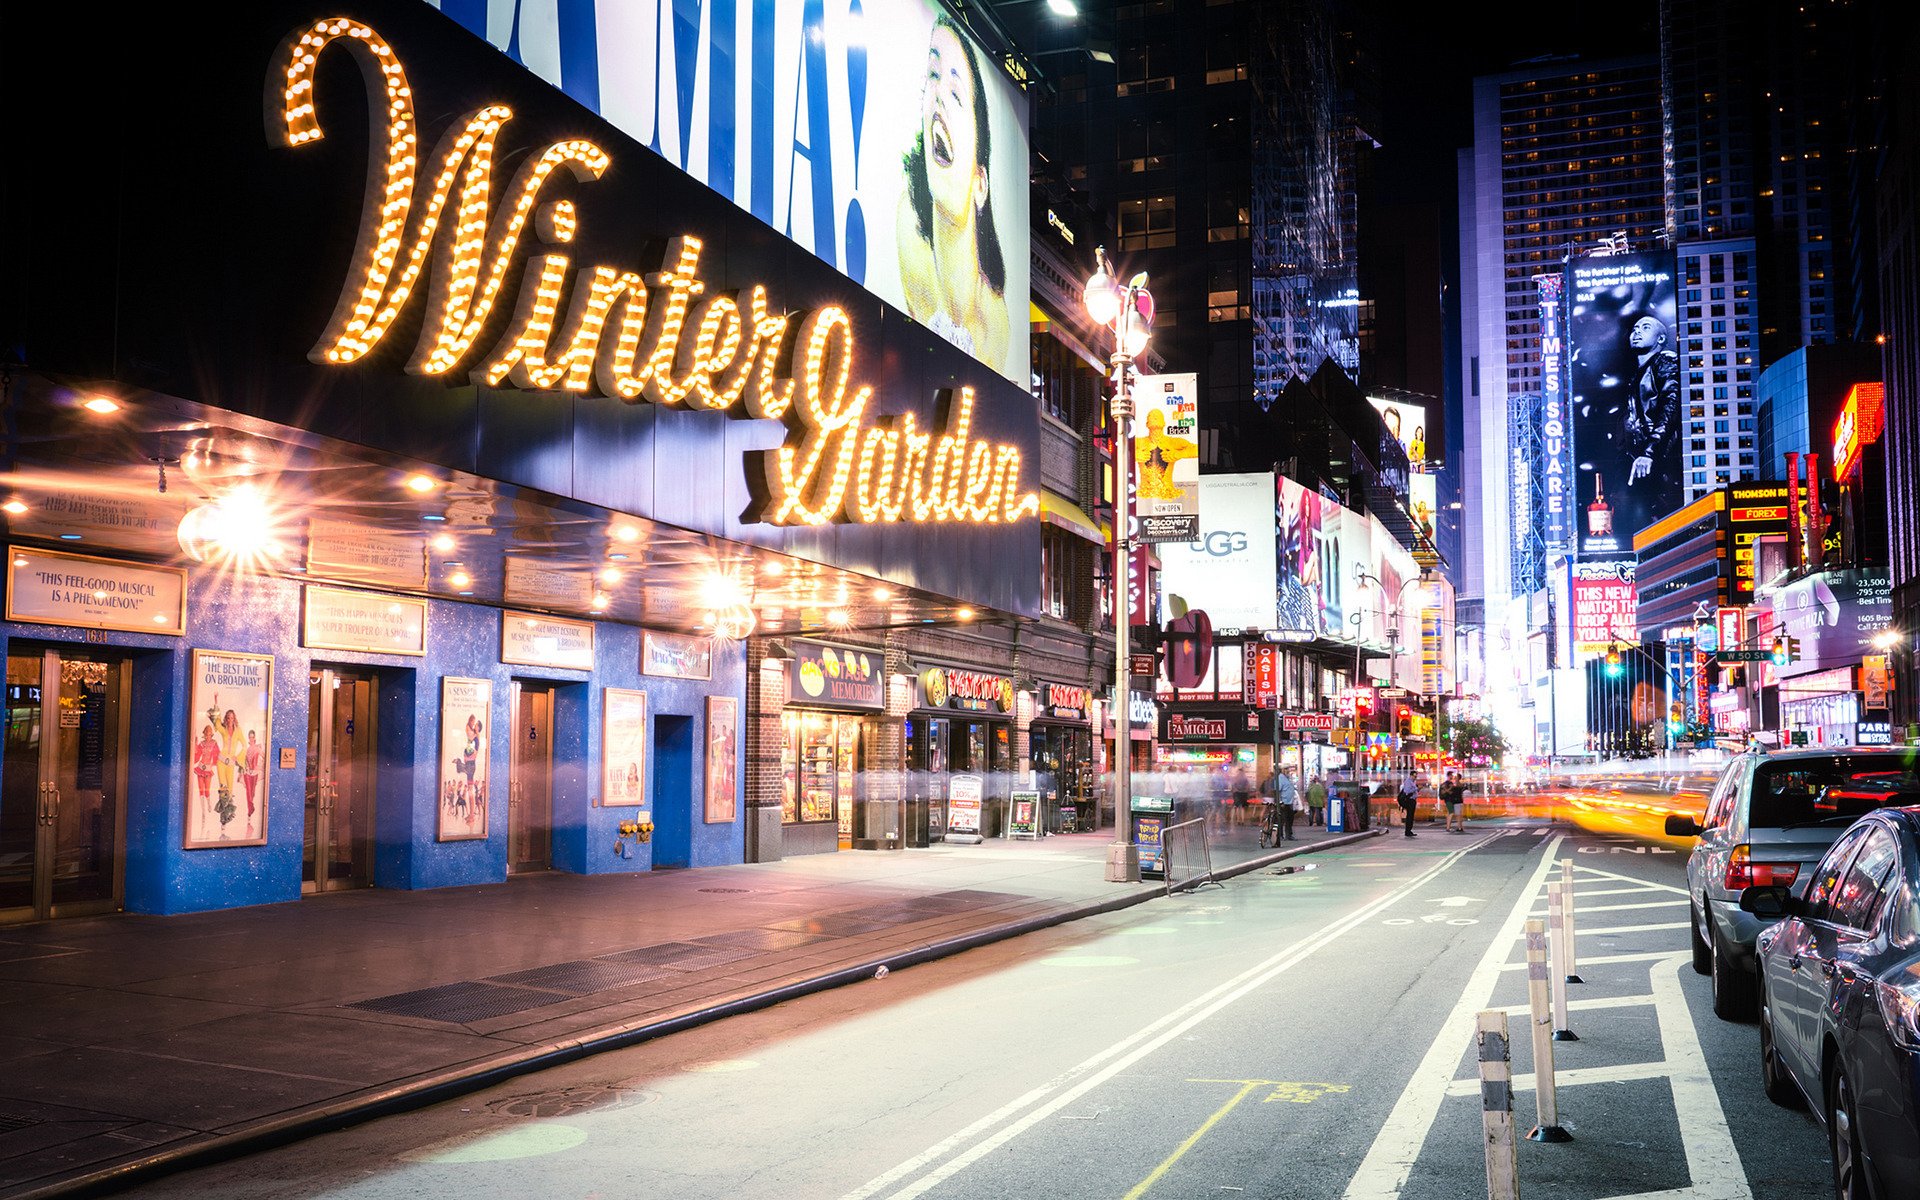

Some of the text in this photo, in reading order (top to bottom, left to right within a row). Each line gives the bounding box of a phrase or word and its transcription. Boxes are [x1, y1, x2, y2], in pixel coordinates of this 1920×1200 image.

[274, 16, 796, 418] Winter
[1575, 269, 1591, 278] The
[1592, 267, 1620, 277] further
[1576, 279, 1591, 288] the
[1592, 277, 1620, 286] further
[1624, 274, 1645, 284] want
[1645, 273, 1655, 282] to
[1576, 293, 1596, 302] NAS
[1541, 301, 1561, 391] TIMES
[766, 303, 1041, 526] Garden
[1544, 401, 1564, 513] SQUARE
[1732, 488, 1777, 499] THOMSON
[1788, 464, 1798, 528] HERSHEYS
[1807, 465, 1818, 529] HERSHEYS
[1746, 509, 1777, 518] FOREX
[1146, 518, 1191, 528] Discovery
[65, 574, 116, 592] FEEL-GOOD
[118, 582, 156, 597] MUSICAL
[51, 589, 61, 602] IS
[63, 591, 71, 603] A
[1576, 586, 1632, 601] THIS NEW
[1577, 600, 1617, 614] WATCH
[1577, 613, 1608, 627] DROP
[1857, 623, 1871, 631] Call
[1577, 627, 1608, 641] YOUR
[1738, 652, 1751, 660] 50
[1754, 651, 1765, 660] St
[222, 663, 241, 675] BEST
[243, 664, 259, 676] TIME
[1260, 648, 1271, 689] OASIS
[205, 674, 217, 685] ON
[831, 680, 876, 702] MEMORIES
[1285, 718, 1331, 728] FAMIGLIA
[1577, 846, 1677, 855] ONL
